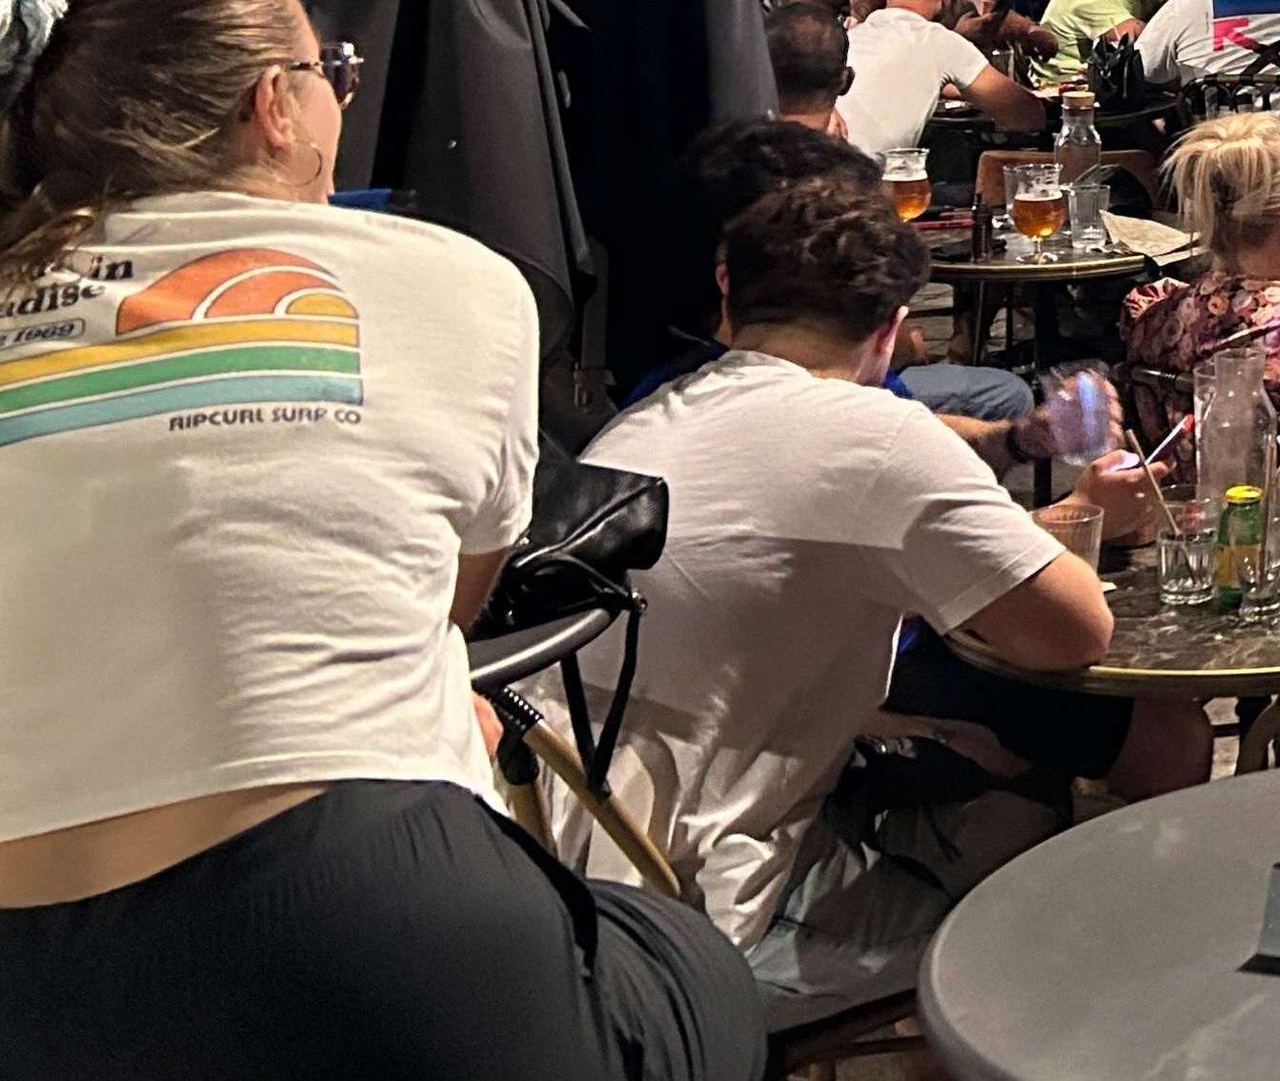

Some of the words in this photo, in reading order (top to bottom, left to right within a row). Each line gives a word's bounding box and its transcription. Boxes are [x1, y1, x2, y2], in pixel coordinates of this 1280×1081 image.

[169, 409, 264, 432] RIPCURL
[271, 407, 328, 423] SURF
[333, 408, 362, 425] CO
